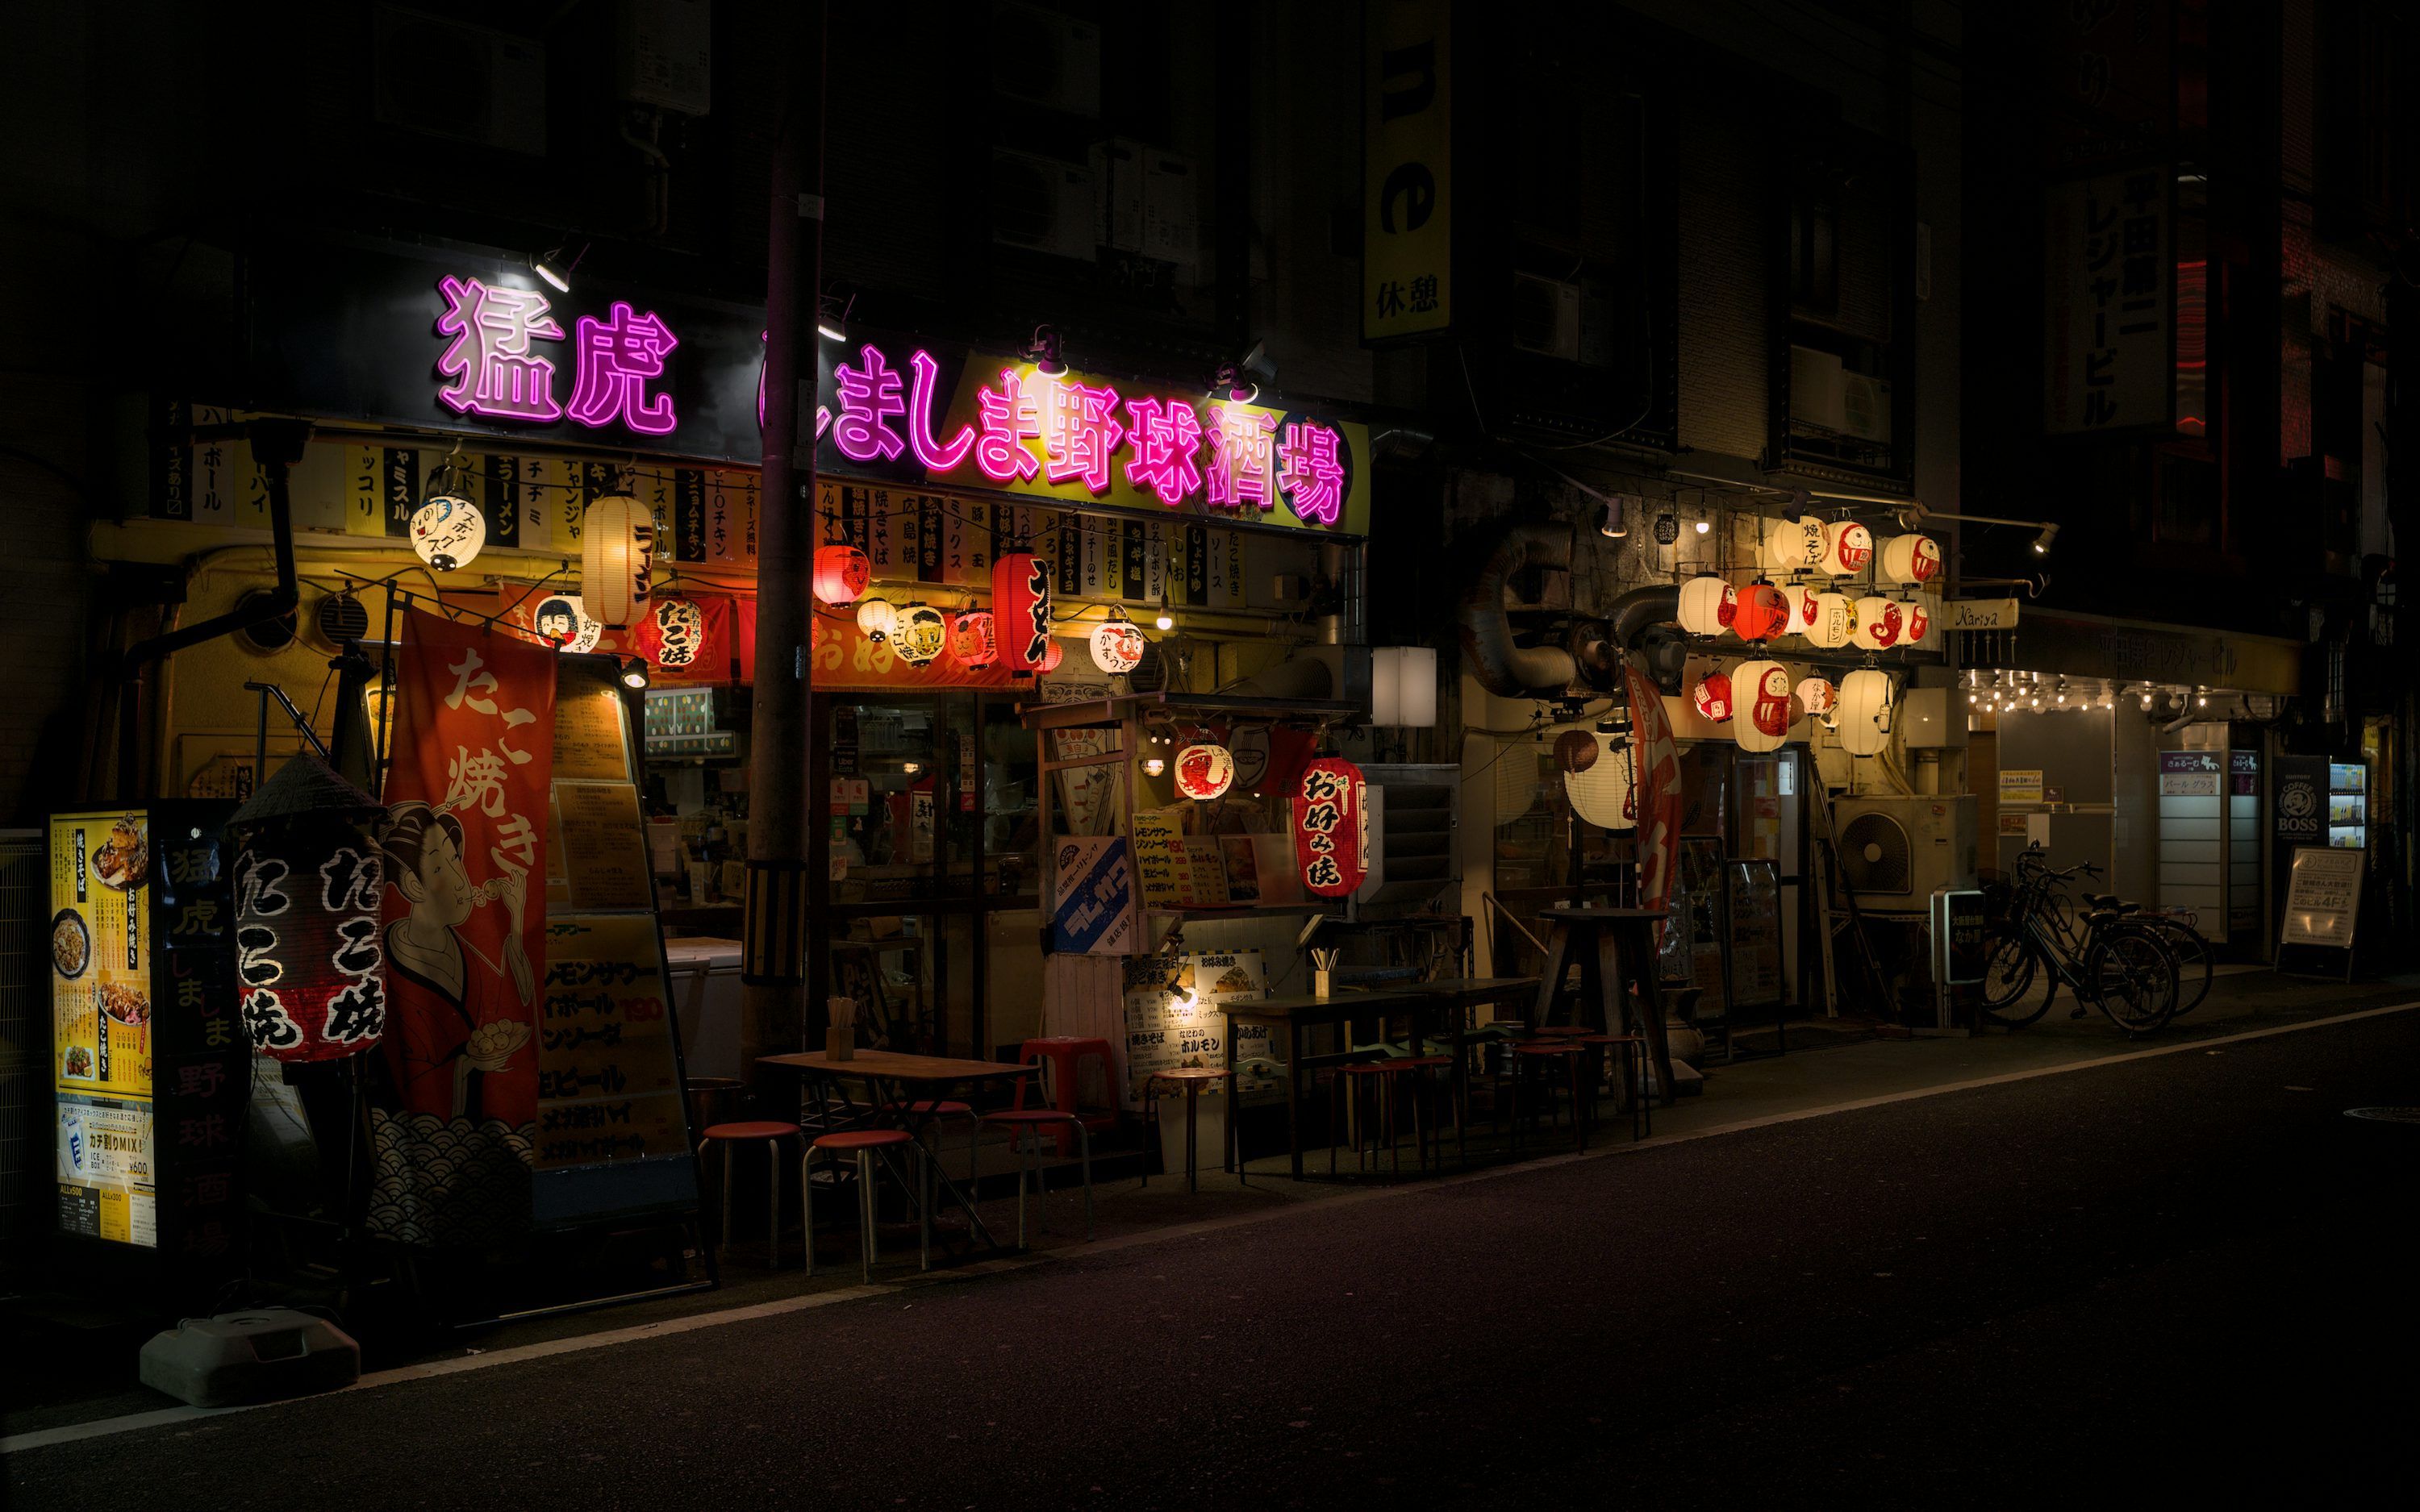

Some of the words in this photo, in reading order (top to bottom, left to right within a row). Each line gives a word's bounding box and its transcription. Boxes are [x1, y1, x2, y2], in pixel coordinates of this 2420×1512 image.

[2120, 177, 2157, 334] 平田第二
[1376, 275, 1437, 319] 休憩
[2086, 198, 2118, 427] レジャービル
[436, 274, 678, 436] 猛虎
[761, 329, 1346, 526] ましま野球酒場
[528, 460, 544, 526] チヂミ
[874, 489, 888, 565] 焼きそば
[903, 498, 917, 564] 広島焼
[950, 499, 962, 569] ミックス
[971, 506, 984, 568] 豚玉
[1045, 515, 1057, 577] とろろ
[1804, 523, 1821, 566] 焼そば
[1191, 529, 1203, 593] しょうゆ
[1212, 538, 1222, 588] ソース
[1229, 531, 1240, 597] たこ焼き
[658, 602, 693, 664] たこ焼
[1024, 557, 1050, 663] うどん
[1832, 610, 1842, 641] ホルモン
[444, 648, 538, 877] たこ焼き
[2282, 781, 2315, 793] COFFEE
[1134, 827, 1173, 838] レモンサワー
[1135, 839, 1169, 851] ジンソーダ
[1168, 839, 1184, 853] 190
[1305, 771, 1341, 885] お好み焼
[2278, 818, 2318, 832] BOSS
[77, 833, 86, 893] 焼きそば
[1139, 855, 1171, 865] ハイボール
[1144, 868, 1170, 879] 生ビール
[172, 847, 223, 935] 猛虎
[127, 888, 137, 964] お好み焼き
[321, 848, 386, 1043] たこ焼
[1127, 971, 1167, 985] たこ焼き
[1201, 956, 1237, 968] お好み焼き
[620, 997, 664, 1022] 190
[1179, 1029, 1204, 1039] なにわの
[99, 1015, 107, 1073] たこ焼き
[1132, 1031, 1165, 1045] 焼きそば
[1182, 1038, 1220, 1053] ホルモン
[91, 1152, 100, 1161] ICE
[91, 1161, 100, 1169] BOX
[129, 1162, 148, 1174] ¥600
